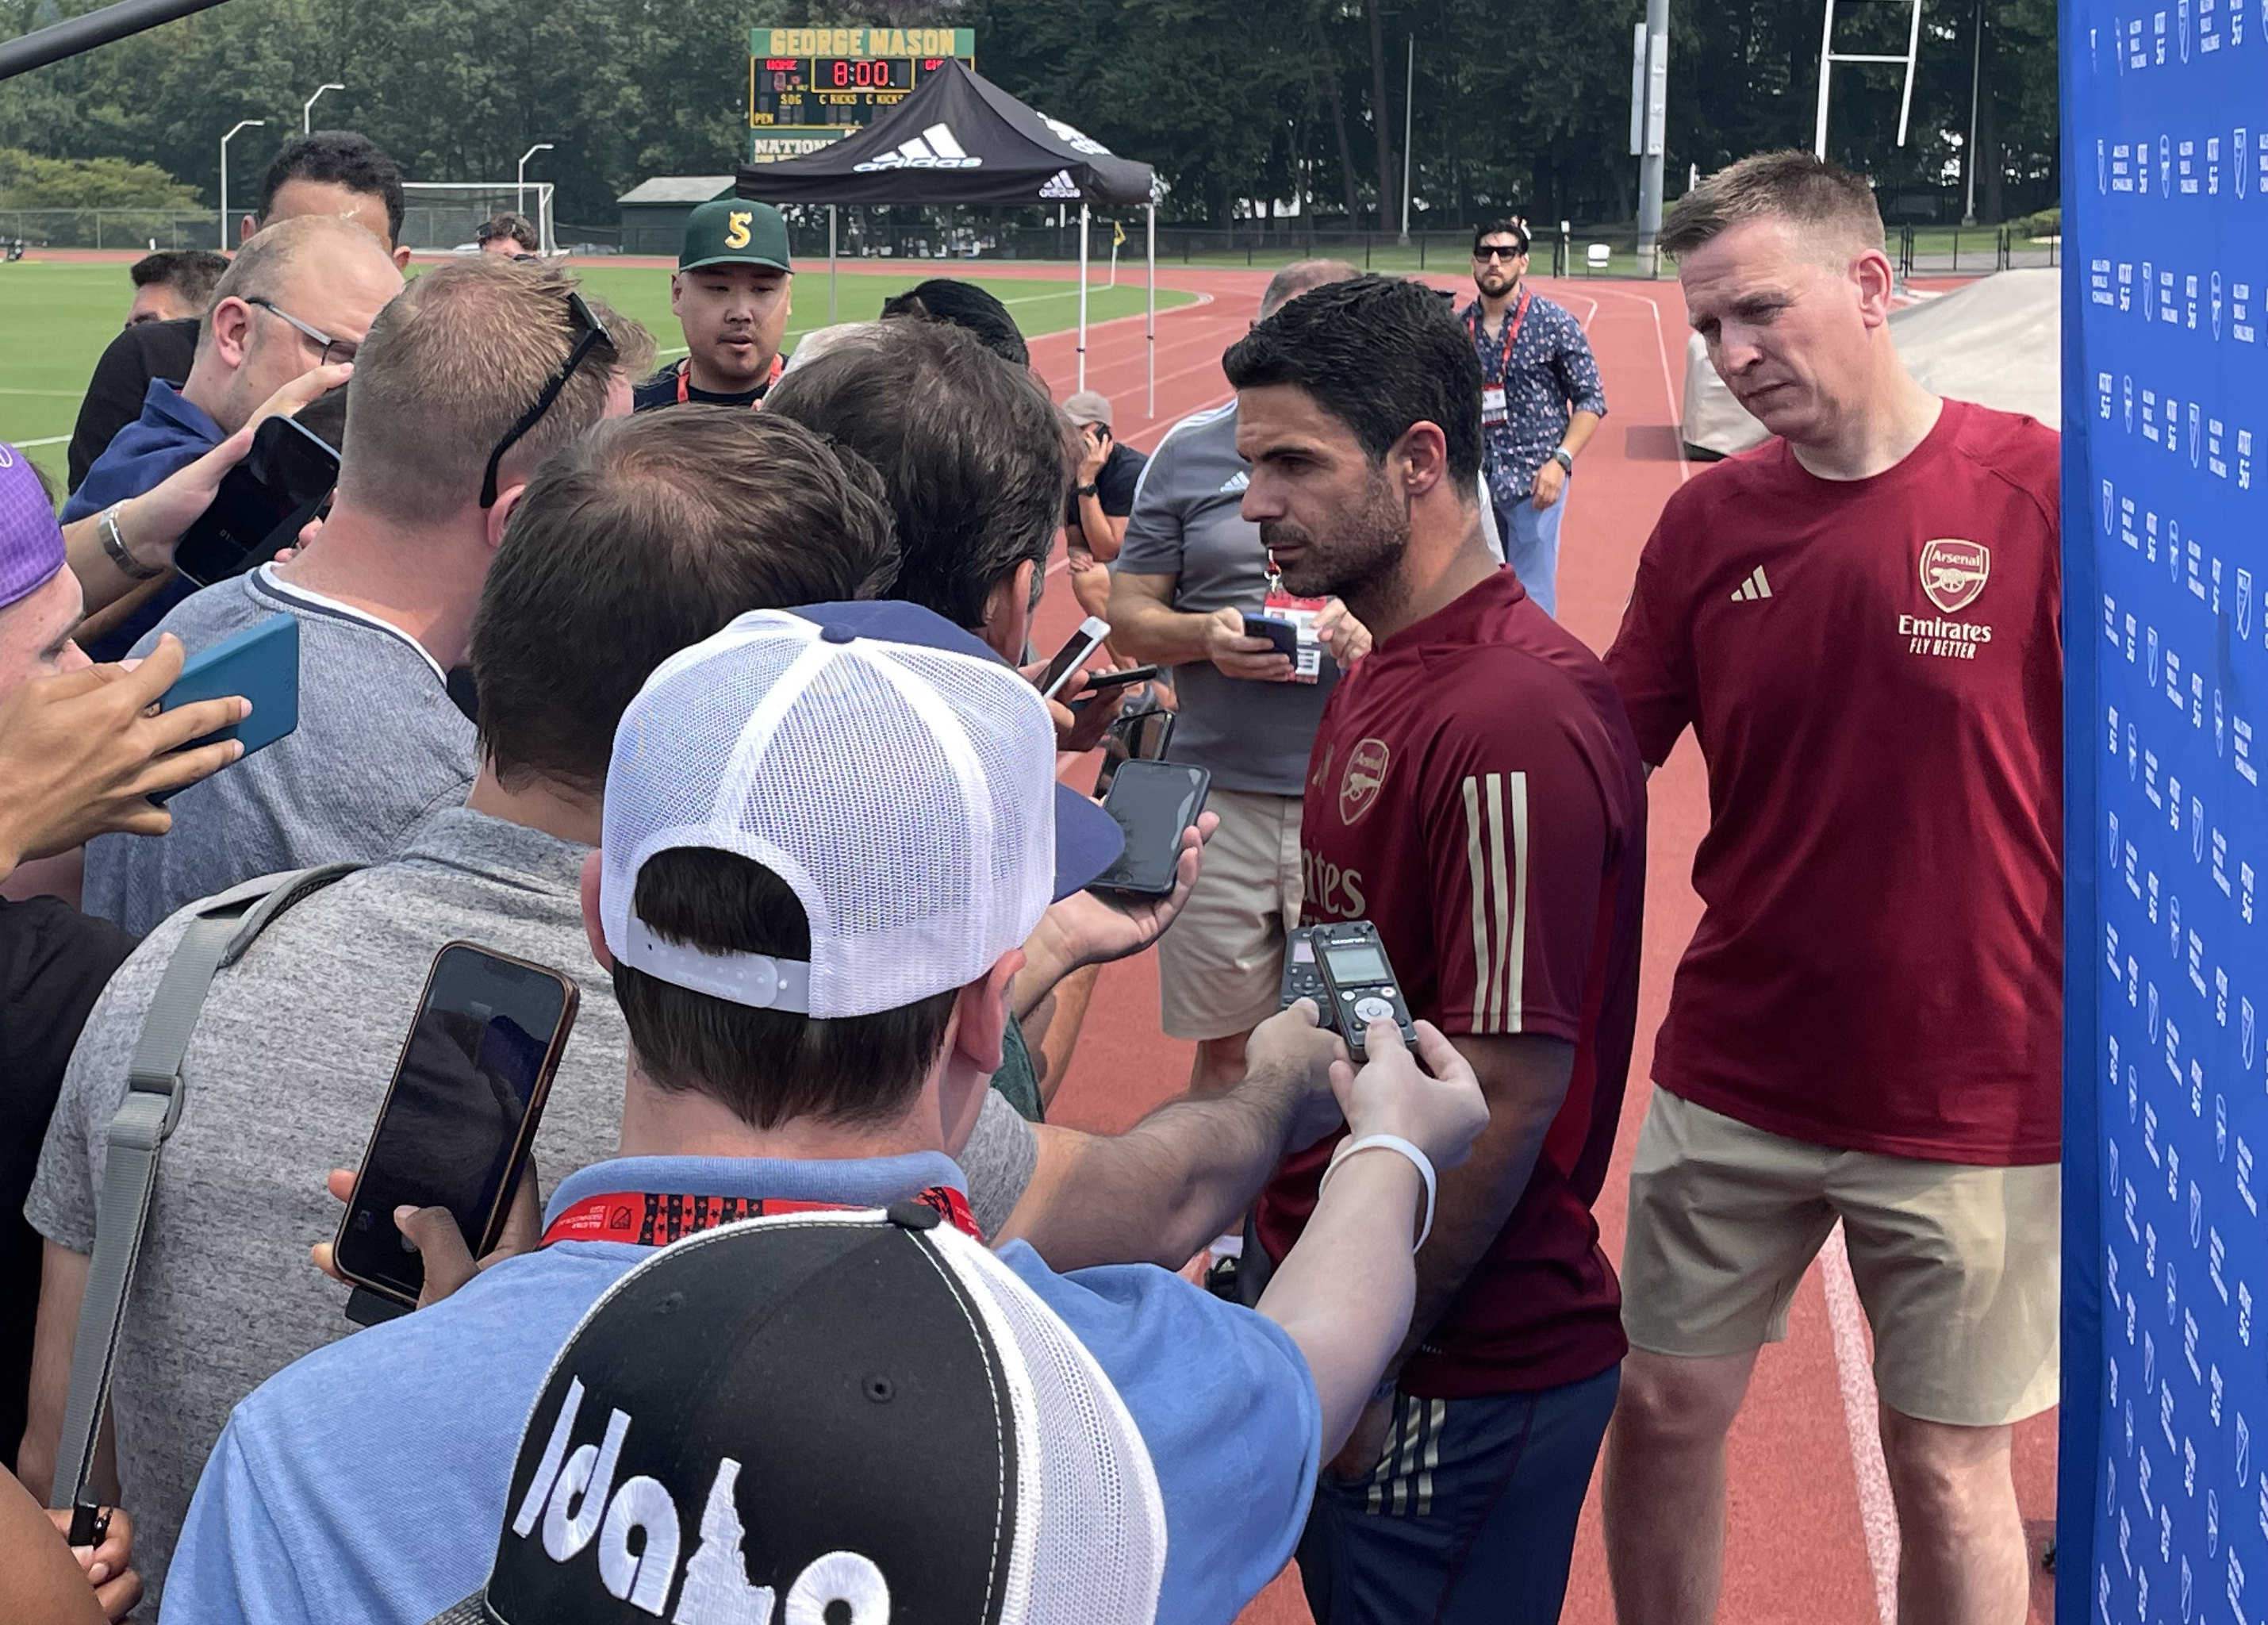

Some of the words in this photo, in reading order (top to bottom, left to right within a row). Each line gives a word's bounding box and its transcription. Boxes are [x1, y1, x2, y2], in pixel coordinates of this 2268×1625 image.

[770, 29, 863, 56] GEORGE
[869, 29, 955, 56] MASON
[766, 60, 797, 71] HOME
[834, 61, 888, 86] 8:00
[780, 94, 802, 105] SOG
[819, 94, 827, 105] C
[830, 94, 857, 105] KICKS
[865, 94, 873, 105] C
[853, 156, 983, 172] adidas
[1931, 549, 1980, 567] Arsenal
[1898, 614, 1992, 643] Emirates
[1909, 637, 1931, 655] FLY
[1932, 639, 1977, 659] BETTER
[1301, 848, 1365, 918] ates
